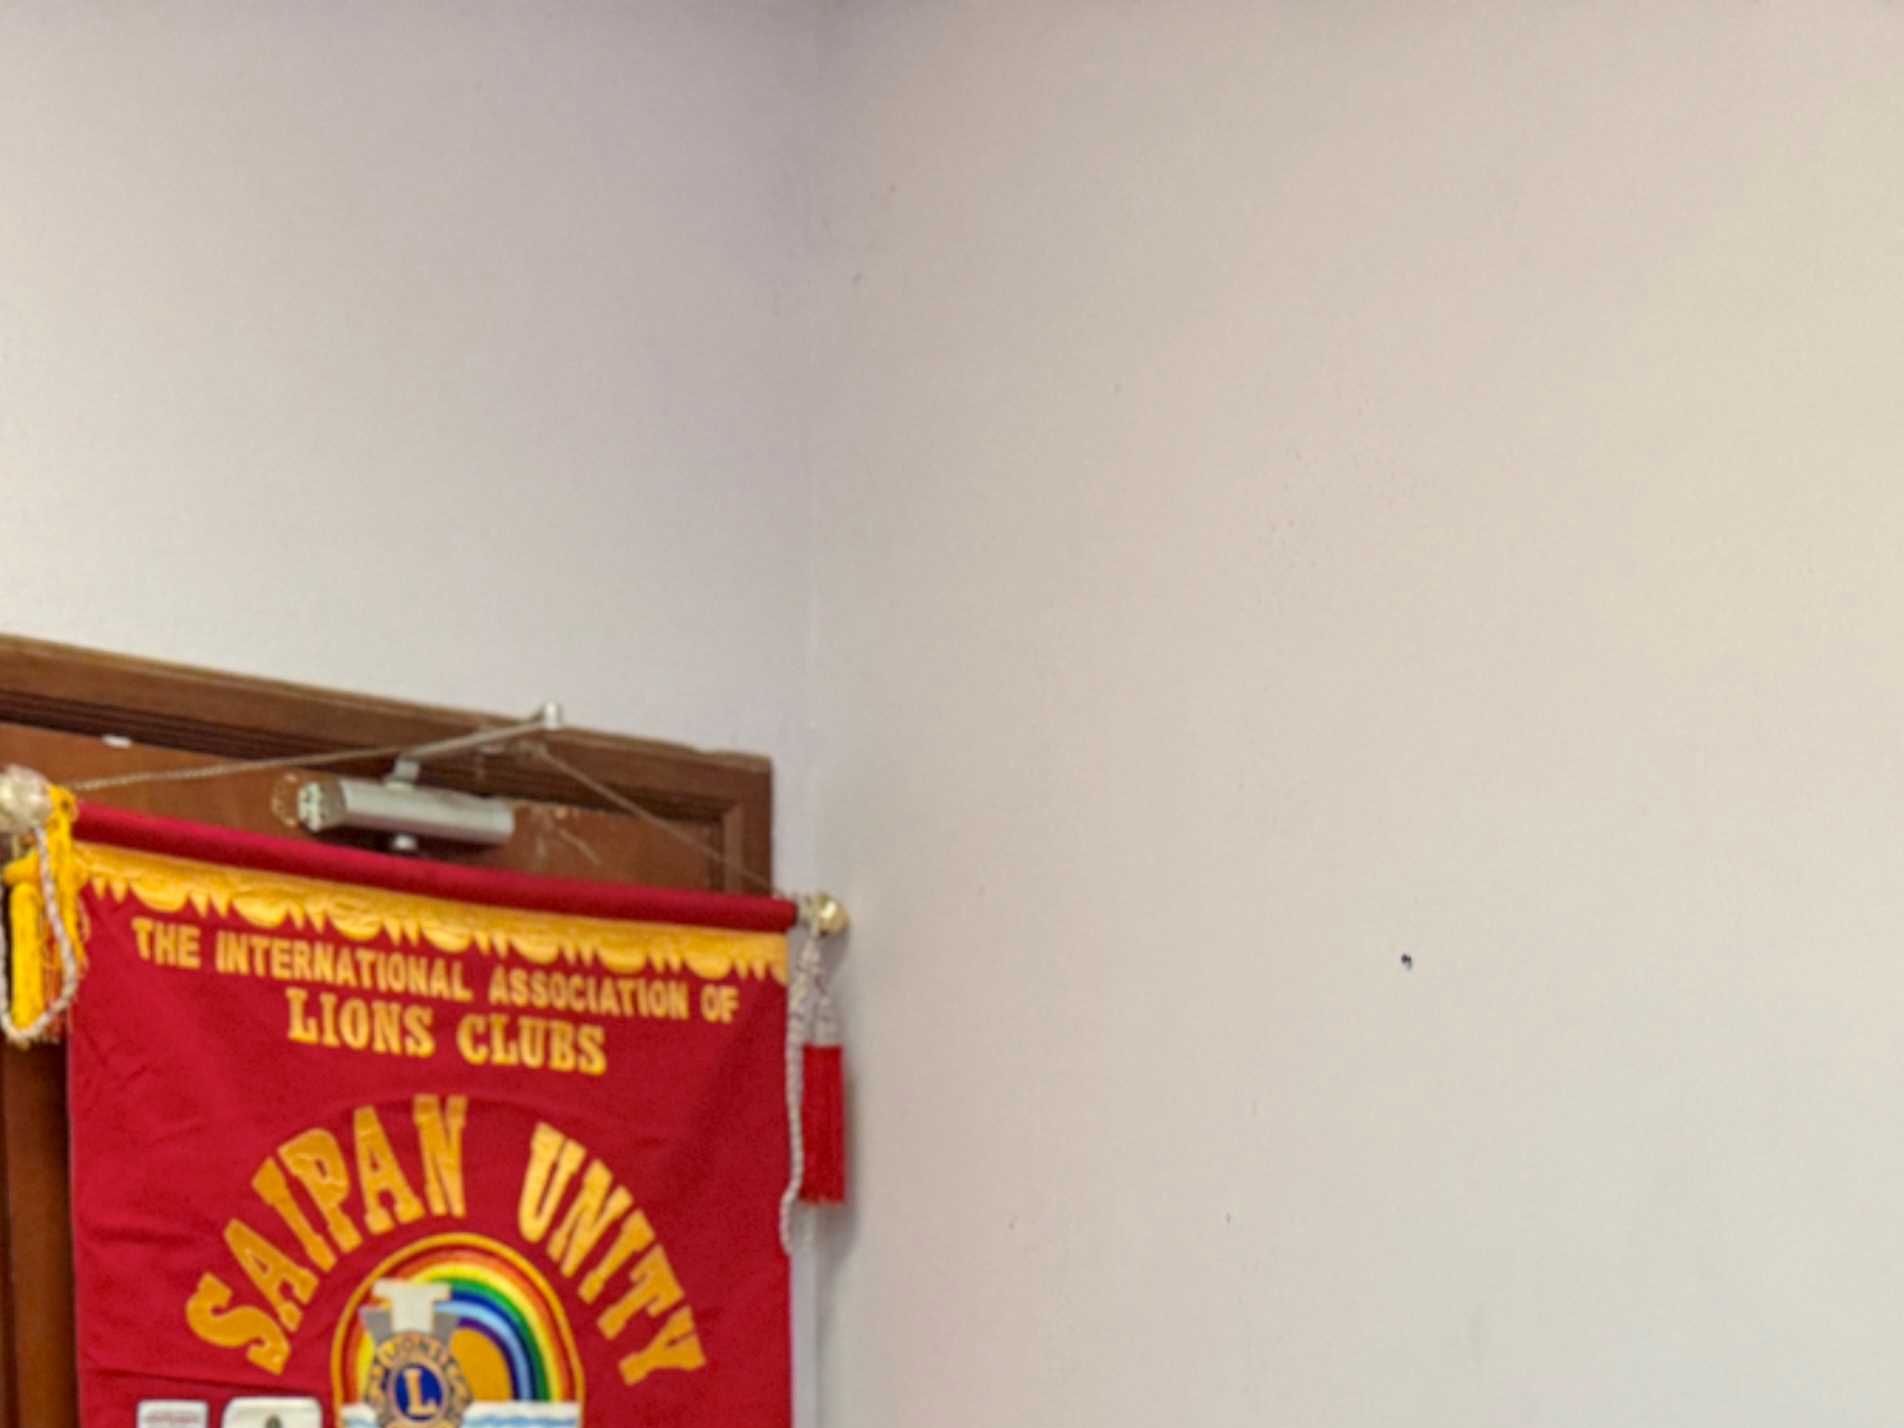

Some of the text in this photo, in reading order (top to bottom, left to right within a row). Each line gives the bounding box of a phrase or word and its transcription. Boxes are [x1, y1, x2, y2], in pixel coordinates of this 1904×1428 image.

[132, 918, 738, 1023] THE INTERNATIONAL ASSOCIATION OF
[286, 988, 607, 1076] LIONS CLUBS
[185, 1094, 707, 1386] SAIPAN UNITY
